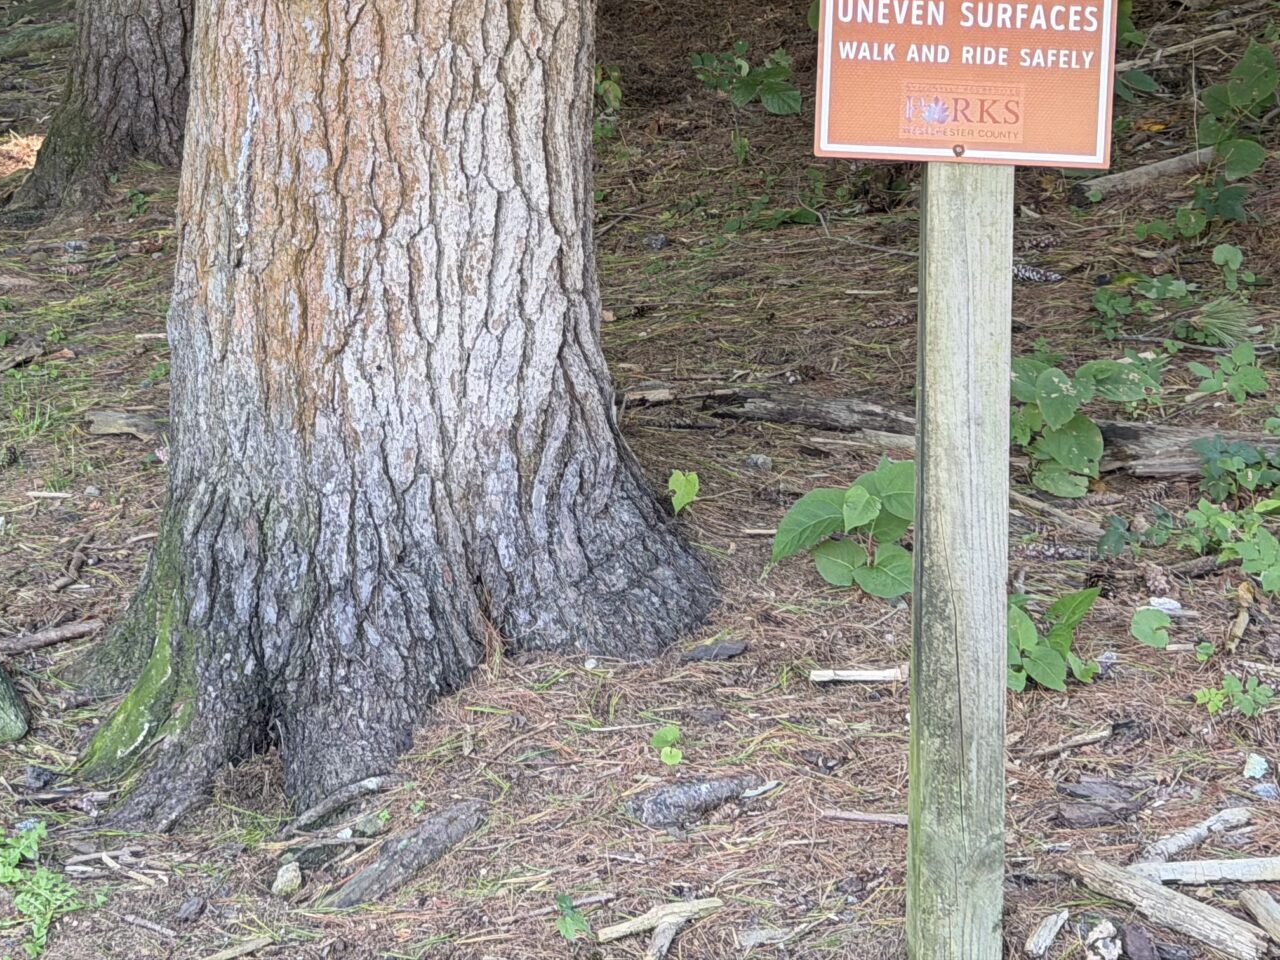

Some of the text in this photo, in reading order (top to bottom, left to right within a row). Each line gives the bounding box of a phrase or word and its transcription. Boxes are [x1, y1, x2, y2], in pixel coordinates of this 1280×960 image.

[960, 2, 1099, 32] SURFACES
[839, 41, 1094, 69] WALK AND RIDE SAFELY
[977, 128, 1019, 140] COUNTY
